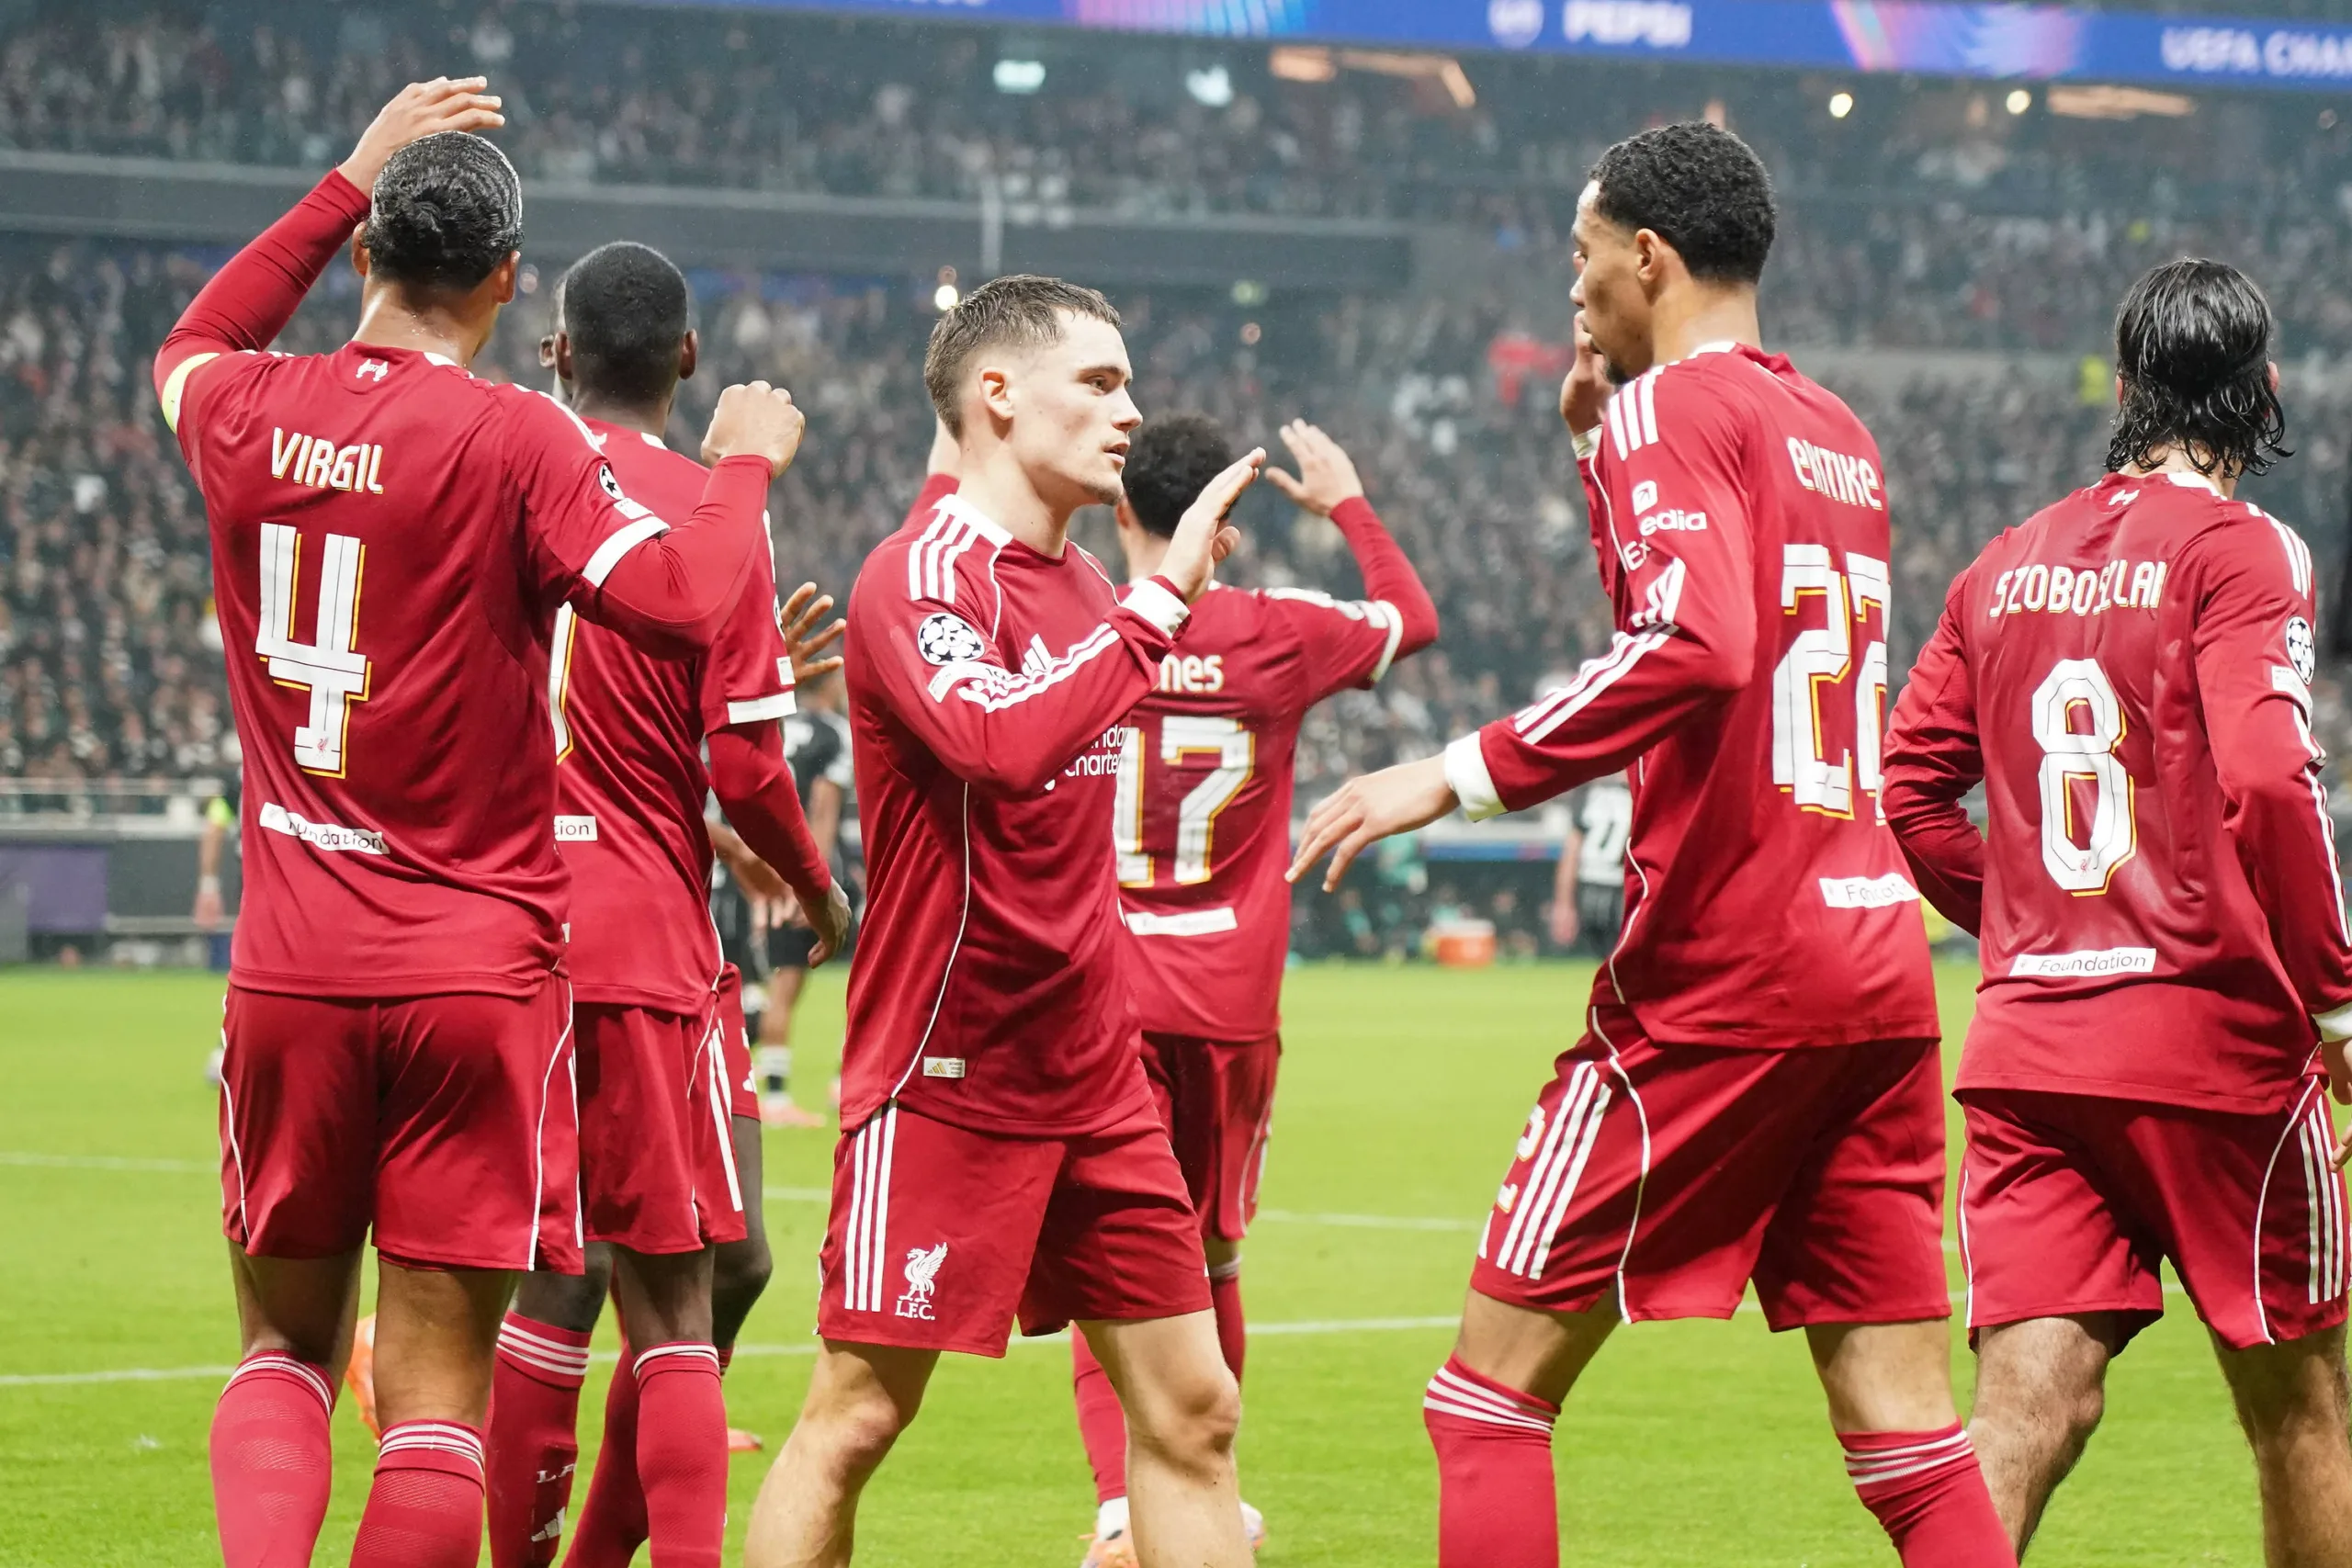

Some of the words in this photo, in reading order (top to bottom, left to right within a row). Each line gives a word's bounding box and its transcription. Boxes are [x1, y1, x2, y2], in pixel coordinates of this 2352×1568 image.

[2162, 26, 2260, 73] UEFA
[272, 427, 384, 494] VIRGIL
[255, 523, 372, 779] 4
[1159, 654, 1224, 693] nes
[1114, 716, 1256, 888] 17
[2031, 658, 2137, 897] 8
[2038, 952, 2147, 973] Foundation
